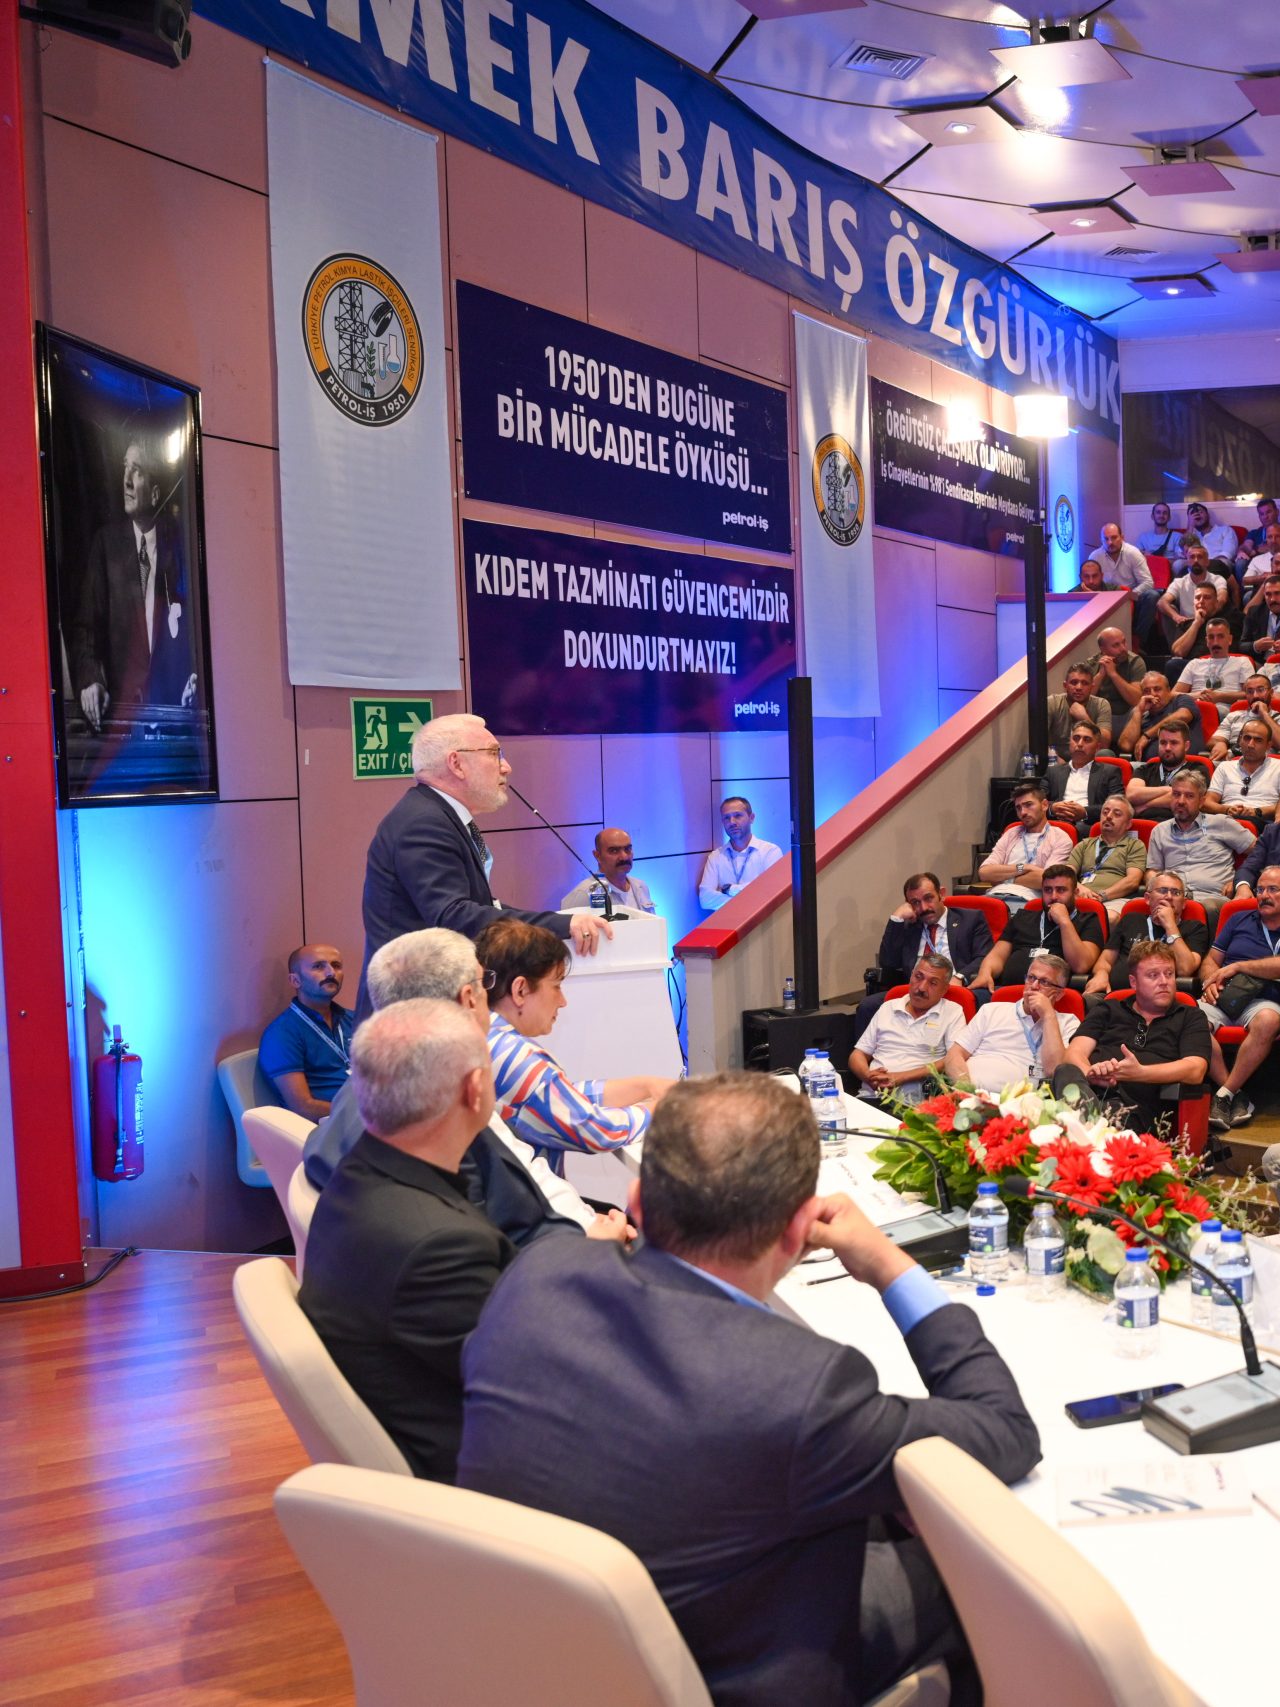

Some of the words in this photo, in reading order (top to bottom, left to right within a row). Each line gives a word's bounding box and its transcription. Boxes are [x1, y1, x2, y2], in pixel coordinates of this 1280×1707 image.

[280, 0, 600, 165] MEK
[635, 77, 864, 312] BARIŞ
[885, 210, 1120, 426] ÖZGÜRLÜK
[313, 273, 334, 303] PETROL
[333, 264, 358, 277] KİMYA
[359, 266, 386, 289] LASTİK
[384, 281, 413, 326] İŞÇİLERİ
[309, 304, 320, 351] TÜRKİYE
[406, 327, 417, 382] SENDİKASI
[326, 374, 376, 421] PETROL-İŞ
[382, 393, 406, 416] 1950
[545, 347, 651, 415] 1950'DEN
[656, 380, 736, 437] BUGÜNE
[496, 389, 543, 446] BİR
[550, 404, 671, 475] MÜCADELE
[674, 433, 769, 496] ÖYKÜSÜ...
[886, 400, 935, 452] ÖRGÜTSÜZ
[880, 454, 888, 483] İş
[888, 460, 929, 490] Cinayetlerinin
[474, 553, 550, 600] KIDEM
[553, 559, 657, 611] TAZMİNATI
[661, 569, 790, 624] GÜVENCEMİZDİR
[563, 629, 737, 675] DOKUNDURTMAYIZ!
[358, 753, 389, 770] EXIT
[398, 752, 413, 773] ÇI
